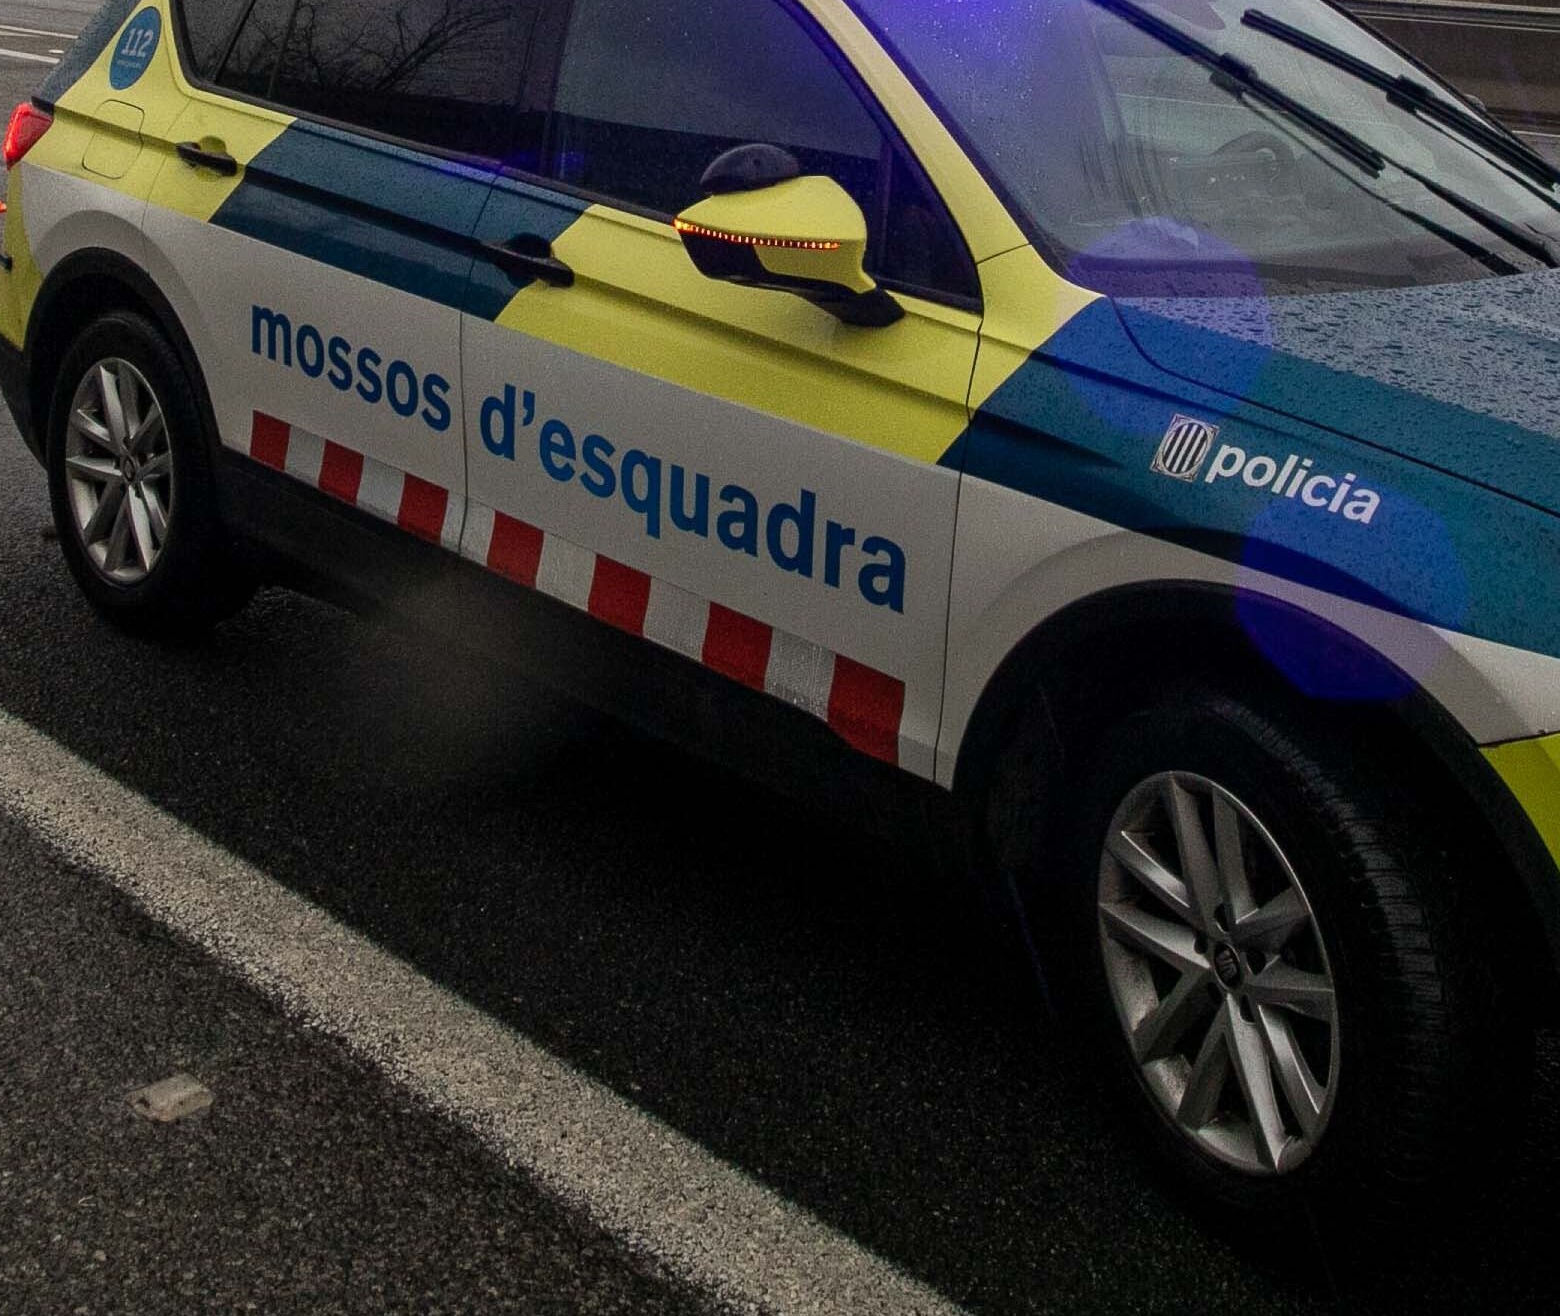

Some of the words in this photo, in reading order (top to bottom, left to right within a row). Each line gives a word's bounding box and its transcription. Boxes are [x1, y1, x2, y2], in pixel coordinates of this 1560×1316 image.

[121, 28, 154, 57] 112
[251, 305, 451, 432] mossos
[480, 384, 907, 614] d'esquadra
[1205, 444, 1381, 524] policia
